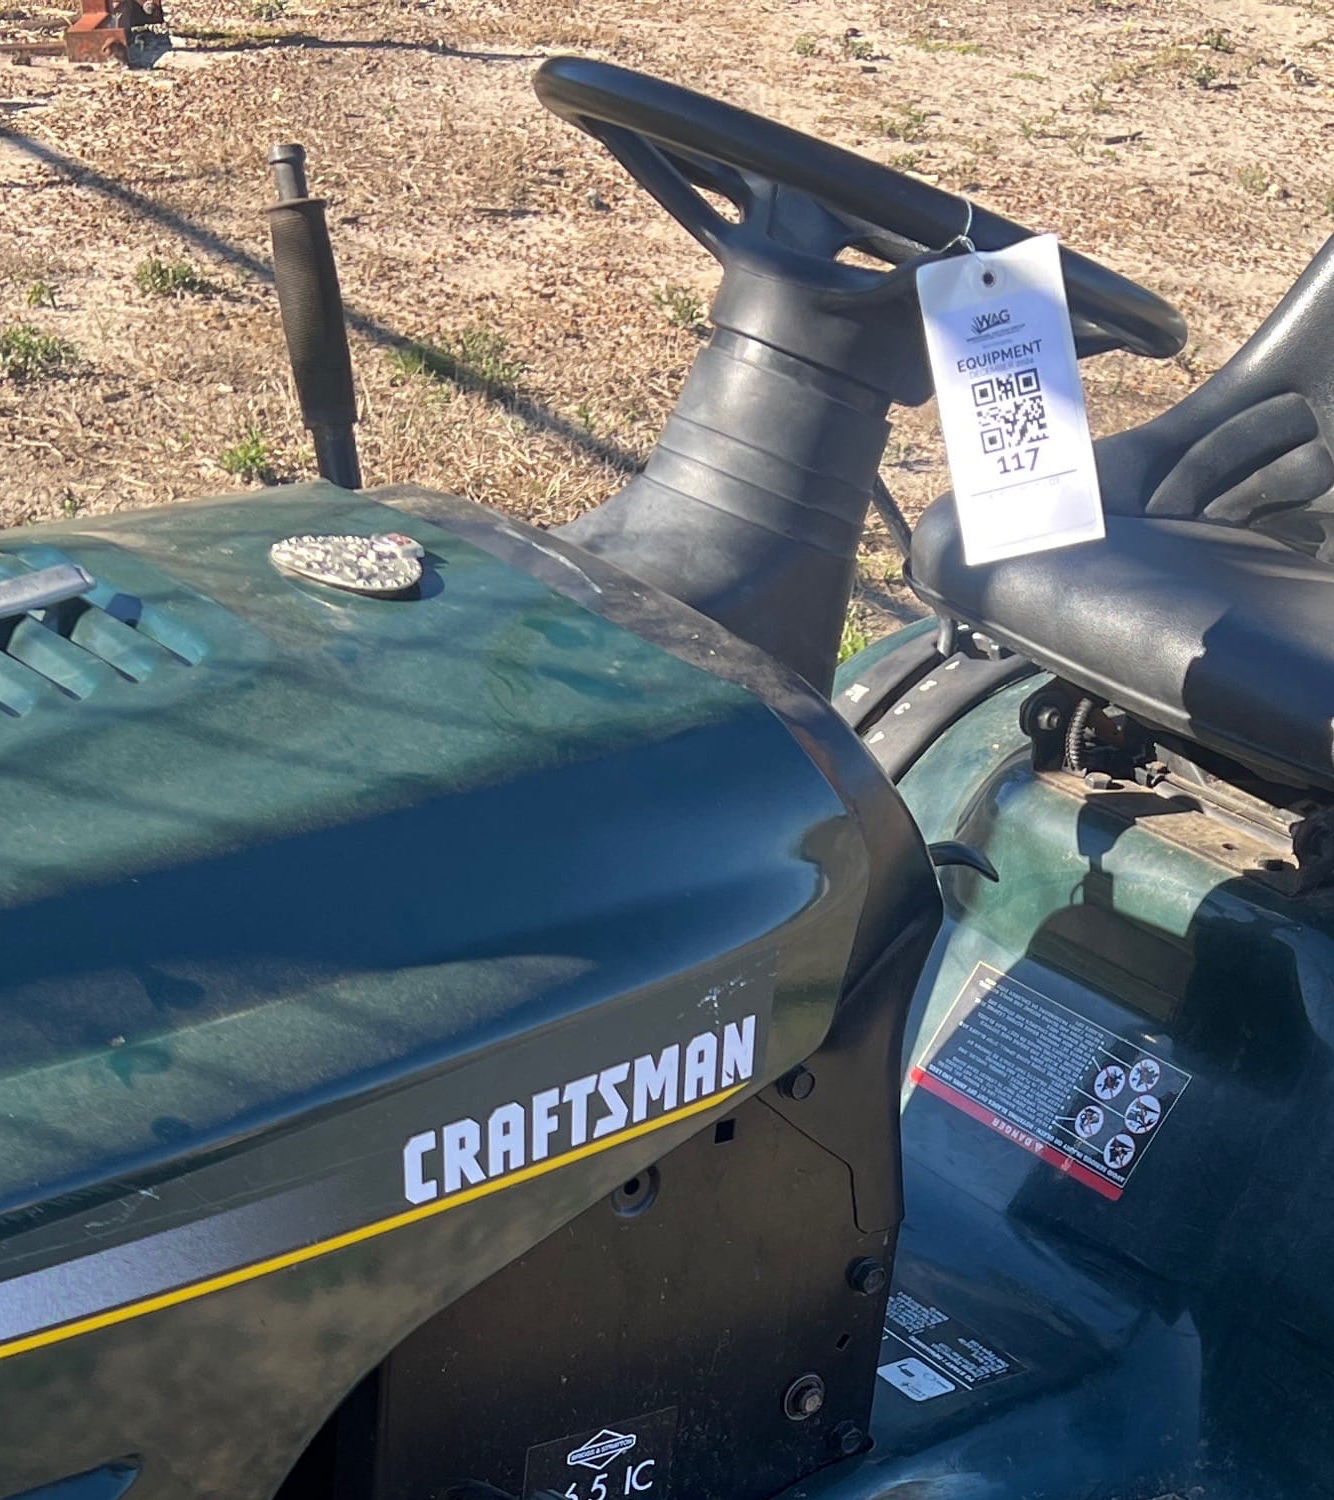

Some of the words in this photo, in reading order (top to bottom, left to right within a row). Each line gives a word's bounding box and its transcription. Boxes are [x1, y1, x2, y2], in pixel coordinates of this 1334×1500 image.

[957, 338, 1043, 373] EQUIPMENT
[997, 448, 1040, 475] 117
[403, 1014, 756, 1205] CRAFTSMAN
[624, 1459, 655, 1495] IC
